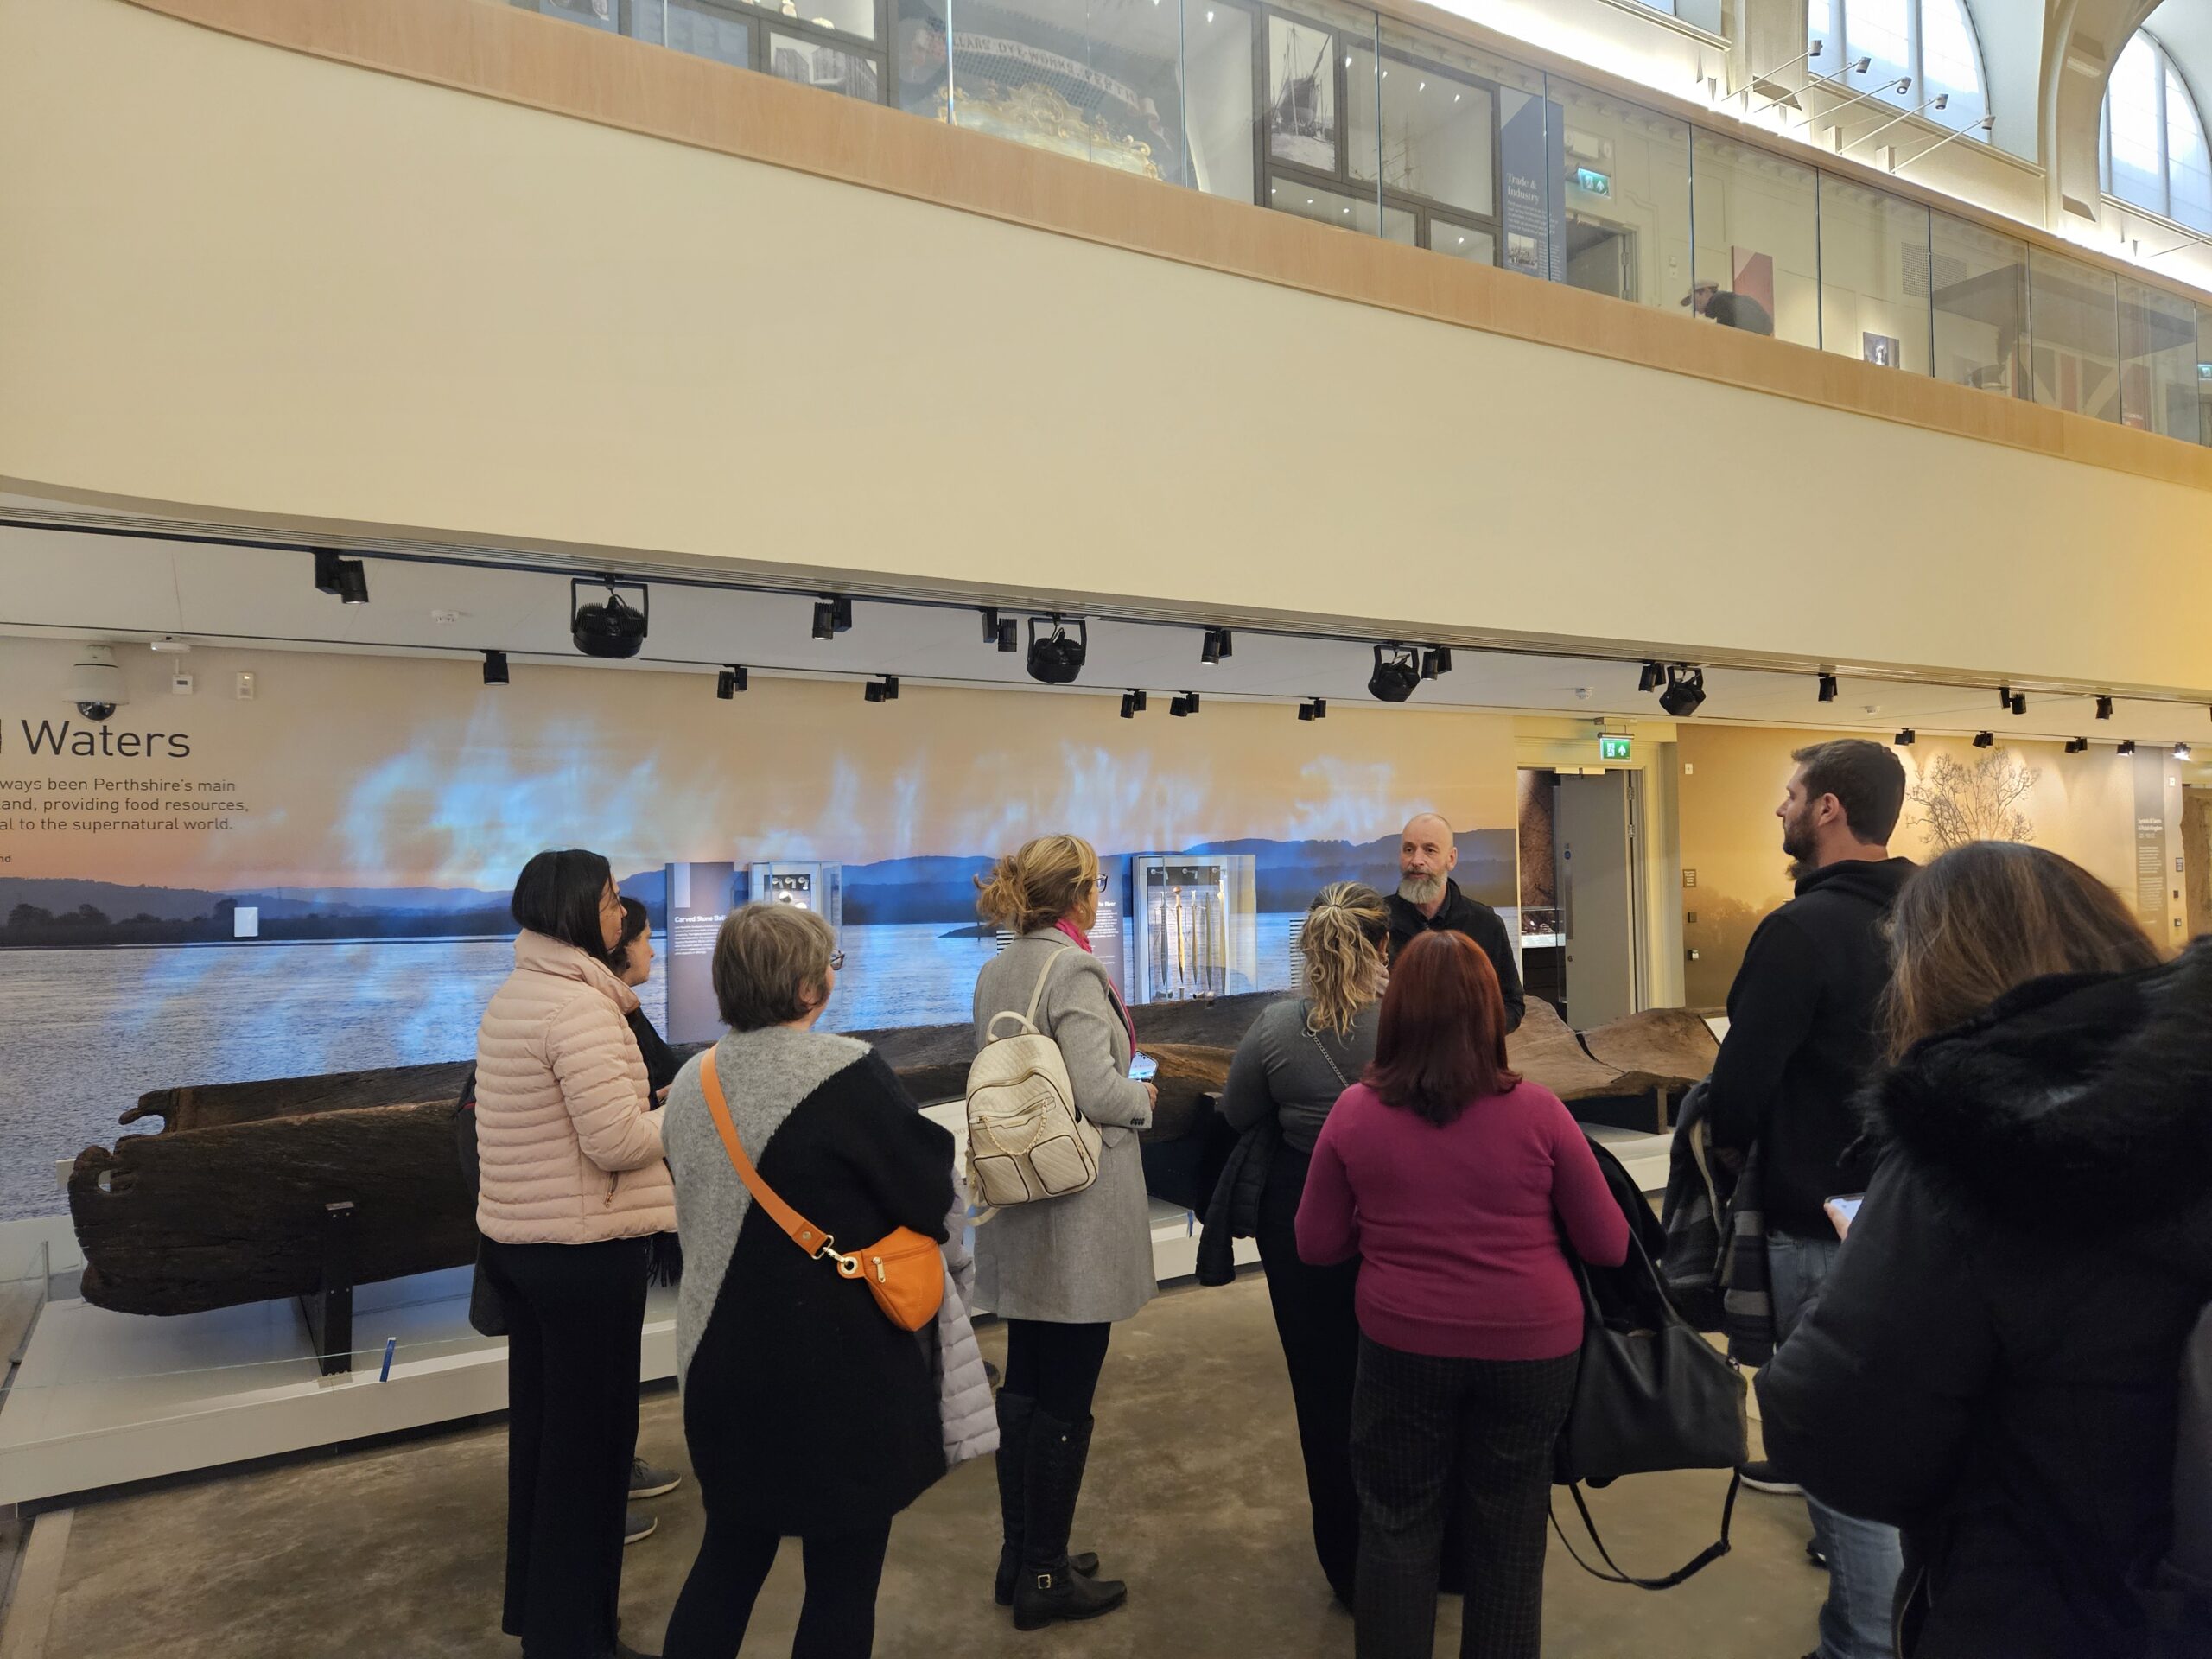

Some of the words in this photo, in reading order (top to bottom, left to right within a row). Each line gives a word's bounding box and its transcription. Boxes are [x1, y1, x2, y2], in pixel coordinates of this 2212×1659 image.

[1507, 173, 1529, 187] Trade
[1530, 179, 1537, 189] &
[1507, 186, 1540, 205] Industry
[21, 719, 191, 758] Waters
[48, 778, 88, 791] been
[94, 778, 193, 791] Perthshire's
[198, 779, 235, 791] main
[0, 798, 37, 811] and,
[43, 798, 119, 813] providing
[125, 798, 159, 810] food
[165, 800, 249, 812] resources,
[20, 819, 35, 830] to
[41, 818, 67, 830] the
[73, 817, 178, 833] supernatural
[183, 818, 233, 830] world.
